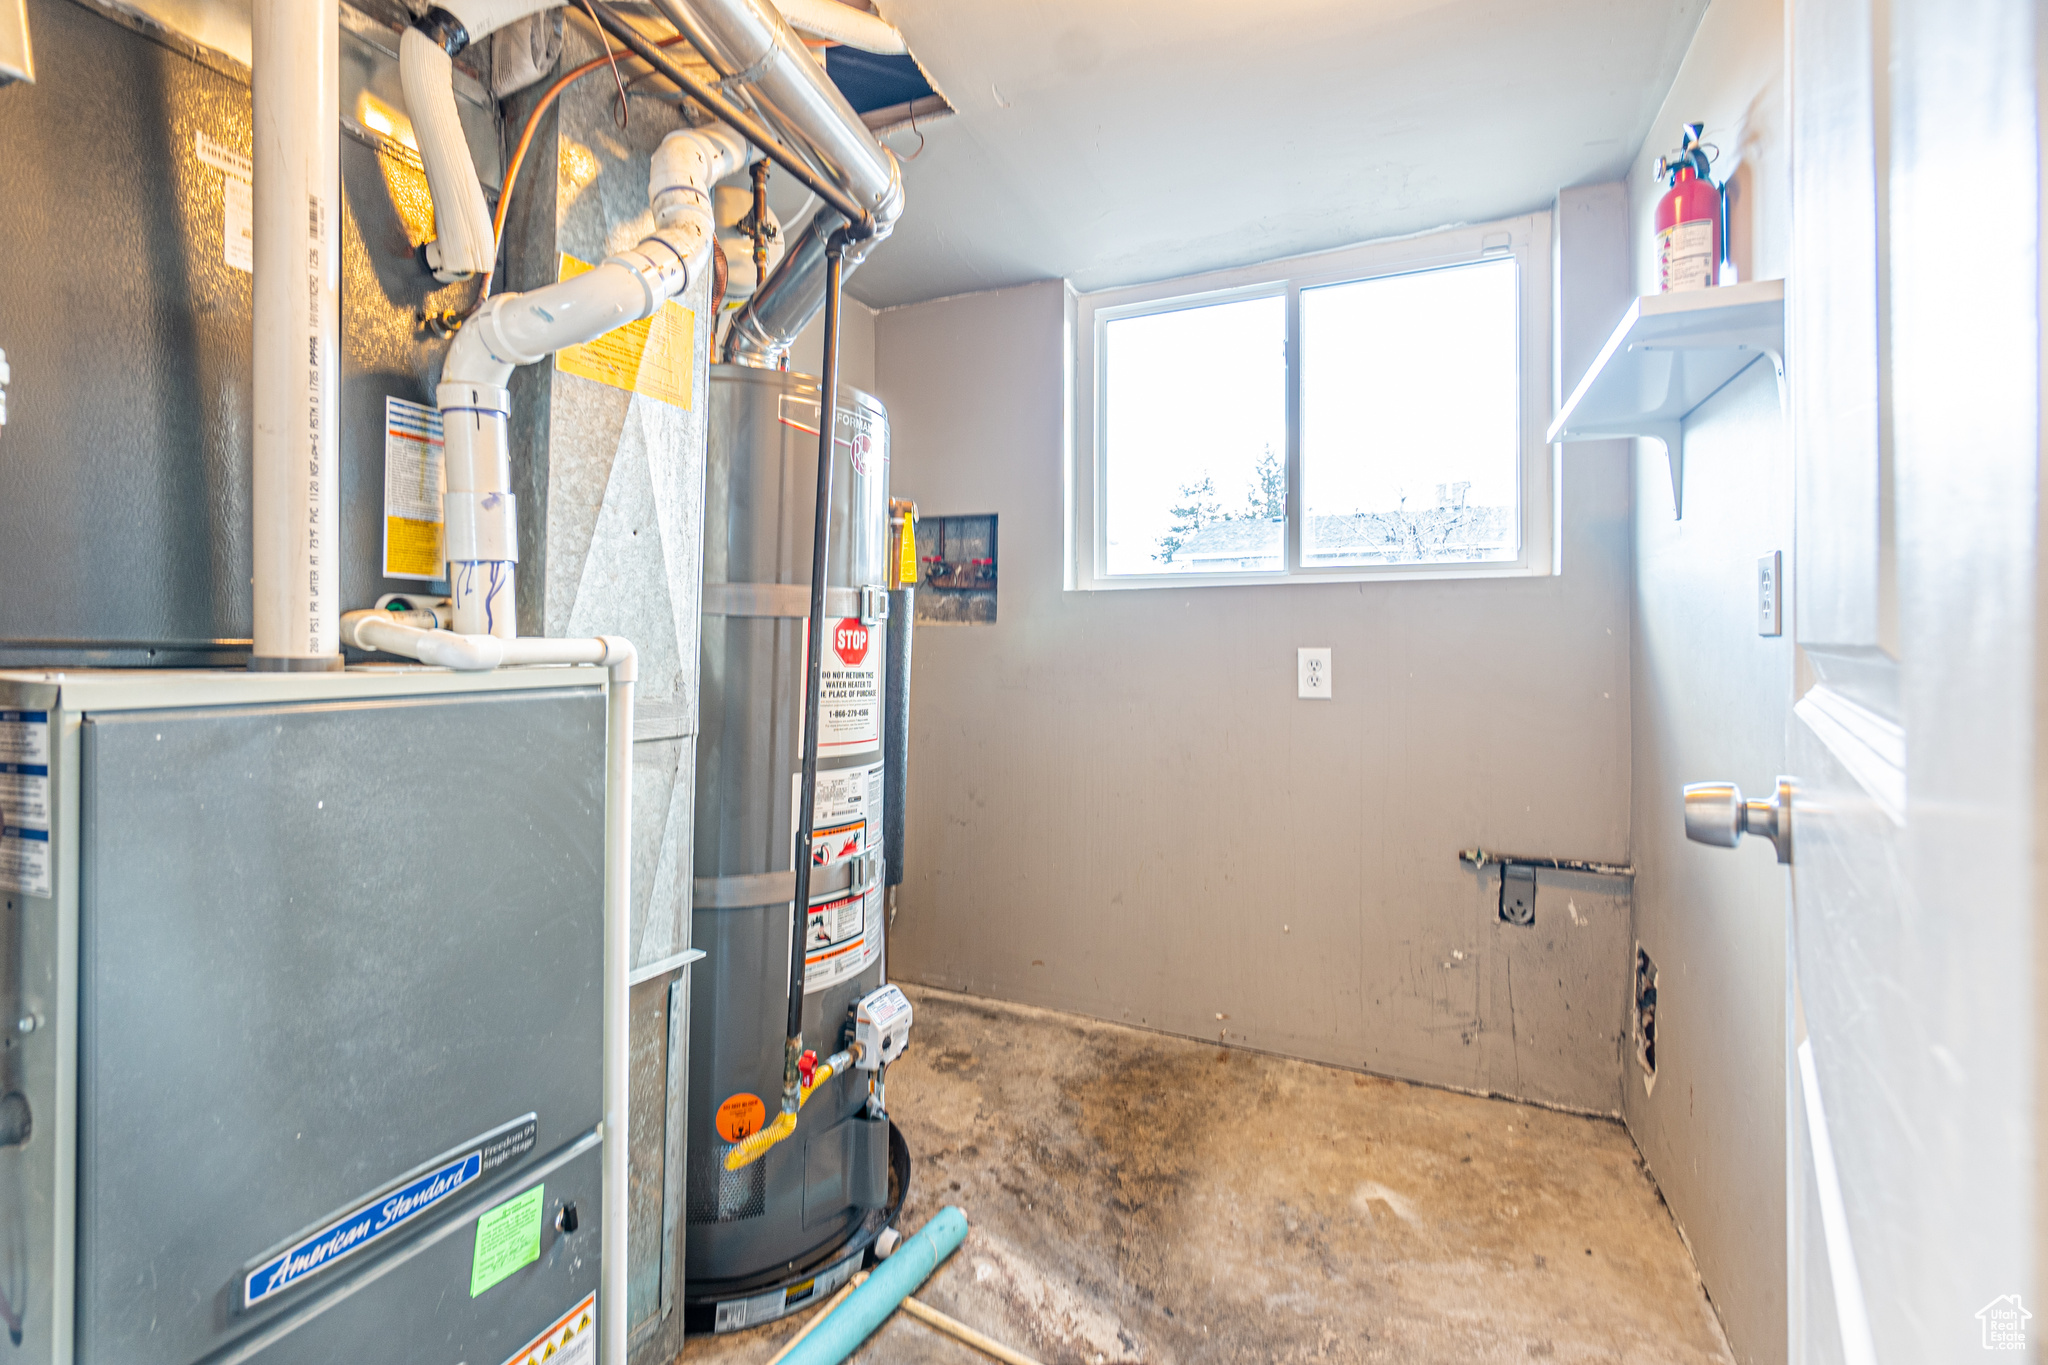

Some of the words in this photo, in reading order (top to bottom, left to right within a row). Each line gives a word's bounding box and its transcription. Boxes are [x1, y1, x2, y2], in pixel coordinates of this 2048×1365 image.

[309, 370, 319, 392] 1785
[309, 396, 319, 404] D
[309, 406, 319, 430] ASTM
[309, 480, 319, 502] 1120
[309, 507, 319, 524] PVC
[309, 554, 319, 565] AT
[309, 569, 319, 597] WATER
[309, 601, 319, 613] PR
[309, 617, 319, 633] PSI
[837, 629, 867, 650] STOP
[822, 671, 831, 679] DO
[832, 671, 845, 680] NOT
[825, 681, 847, 689] WATER
[847, 681, 866, 689] HEATER
[828, 690, 847, 698] PLACE
[856, 689, 877, 697] PURCHASE
[484, 1130, 524, 1159] Freedom
[266, 1217, 370, 1294] American
[375, 1159, 470, 1230] Standard
